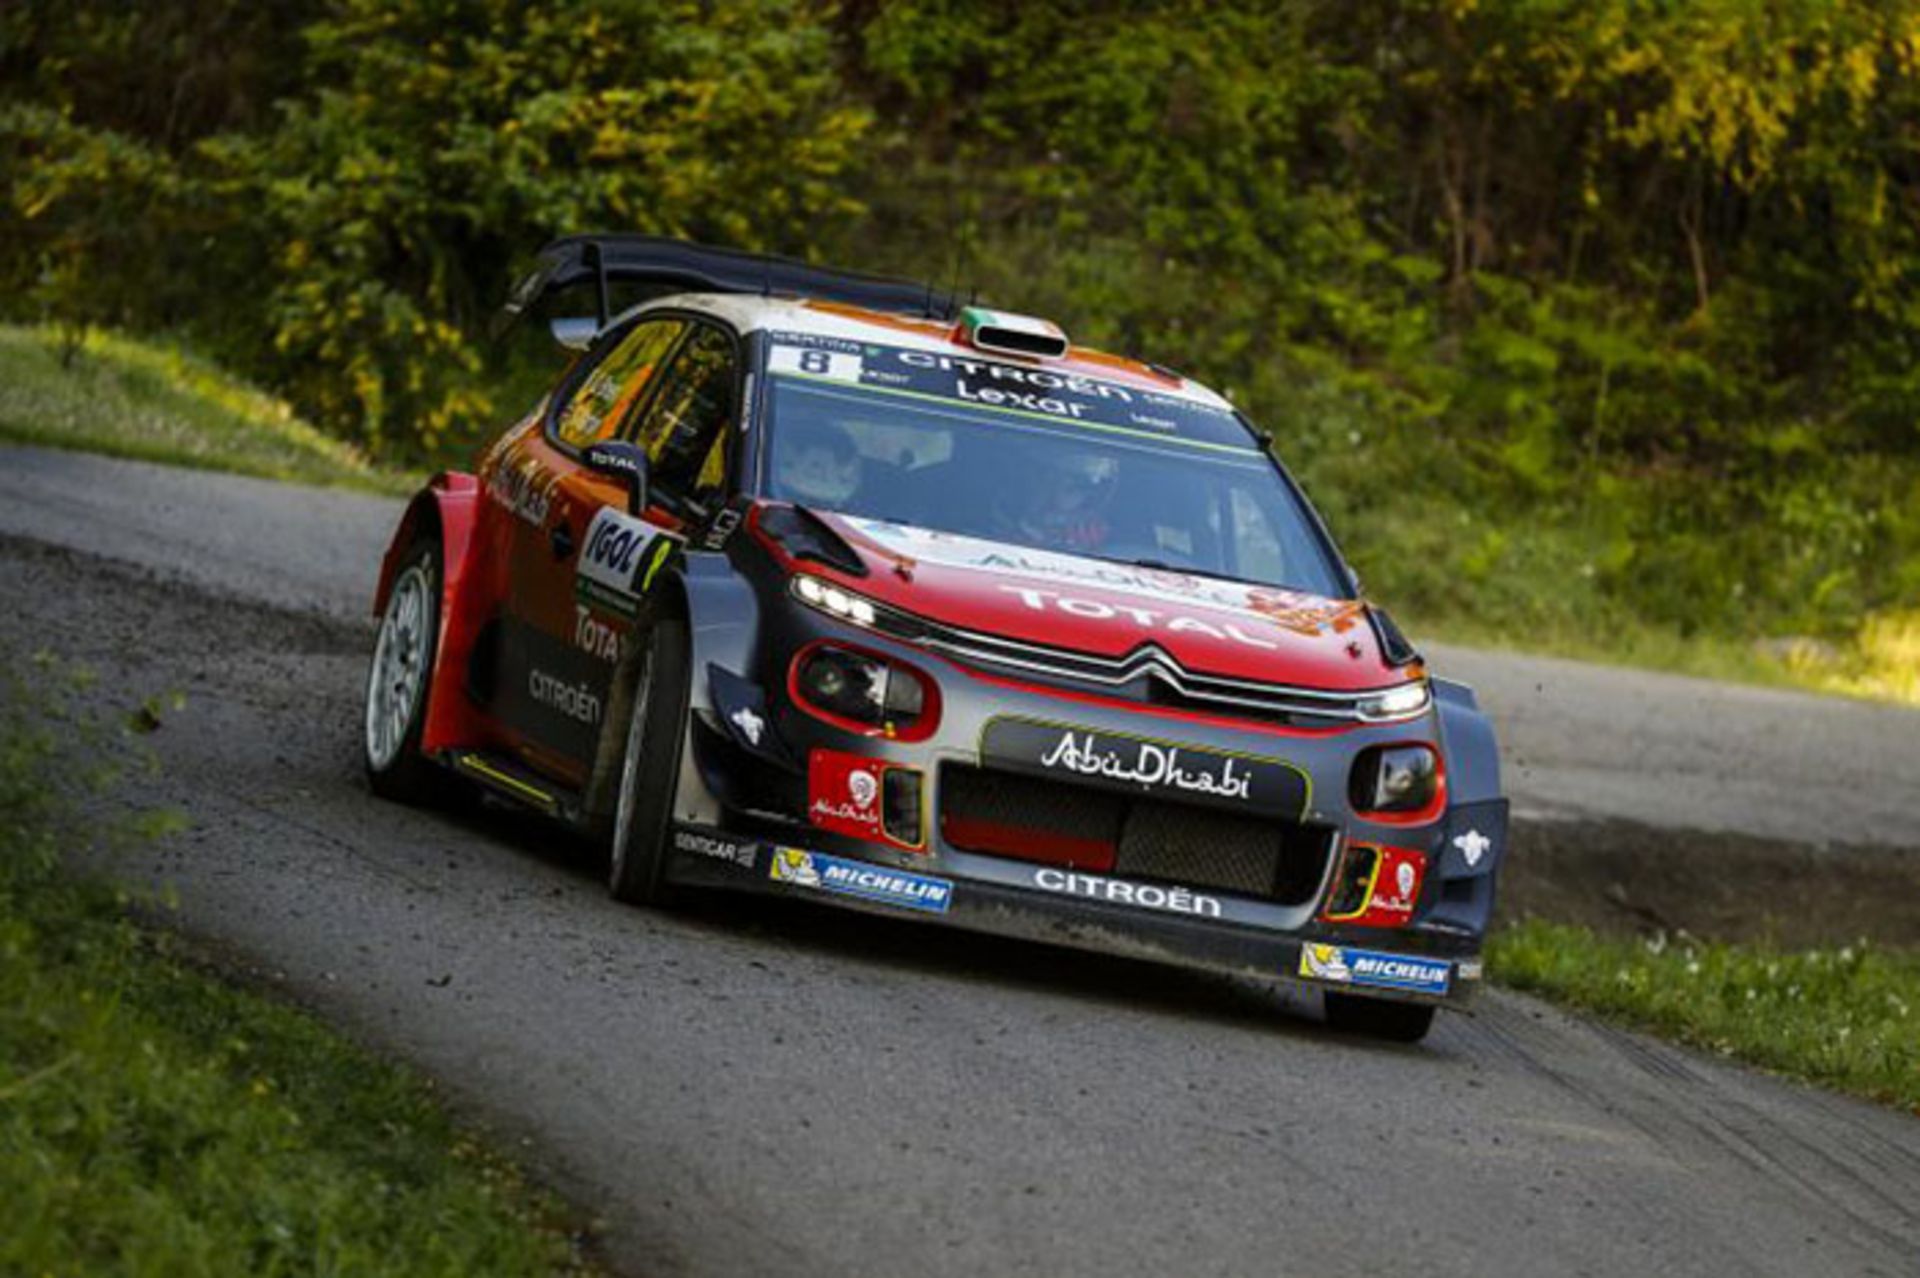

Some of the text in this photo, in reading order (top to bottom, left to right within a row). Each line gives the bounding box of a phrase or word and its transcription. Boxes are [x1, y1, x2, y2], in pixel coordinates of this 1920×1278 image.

[801, 351, 830, 373] 8
[591, 452, 637, 470] TOTAL
[586, 519, 644, 574] IGOL
[575, 605, 620, 664] TOTA
[998, 584, 1278, 650] TOTAL
[824, 864, 947, 902] MICHELIN
[1354, 957, 1446, 983] MICHELIN
